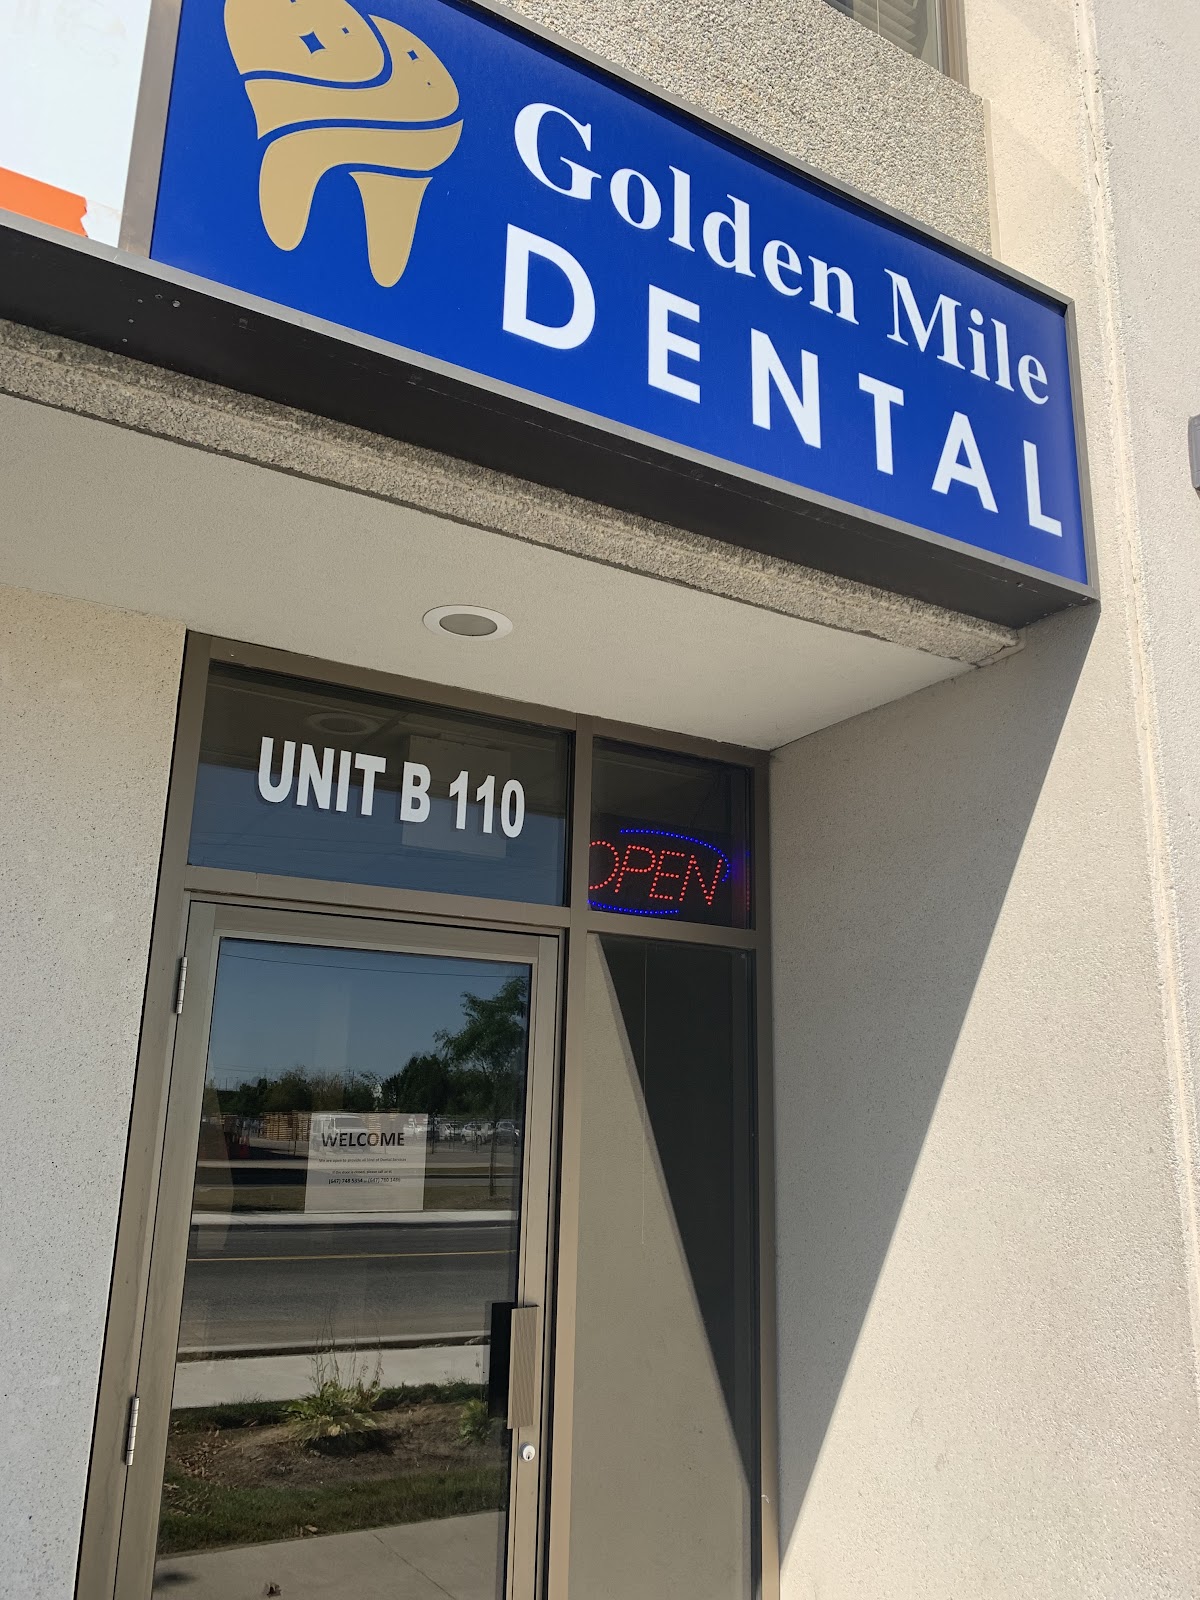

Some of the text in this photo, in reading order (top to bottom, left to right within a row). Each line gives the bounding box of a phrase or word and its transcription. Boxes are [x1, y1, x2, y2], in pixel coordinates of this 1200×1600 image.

[514, 102, 1050, 405] Golden Mile
[502, 223, 1063, 538] DENTAL
[257, 736, 526, 838] UNIT B 110
[588, 840, 724, 906] OPEN
[321, 1131, 405, 1147] WELCOME
